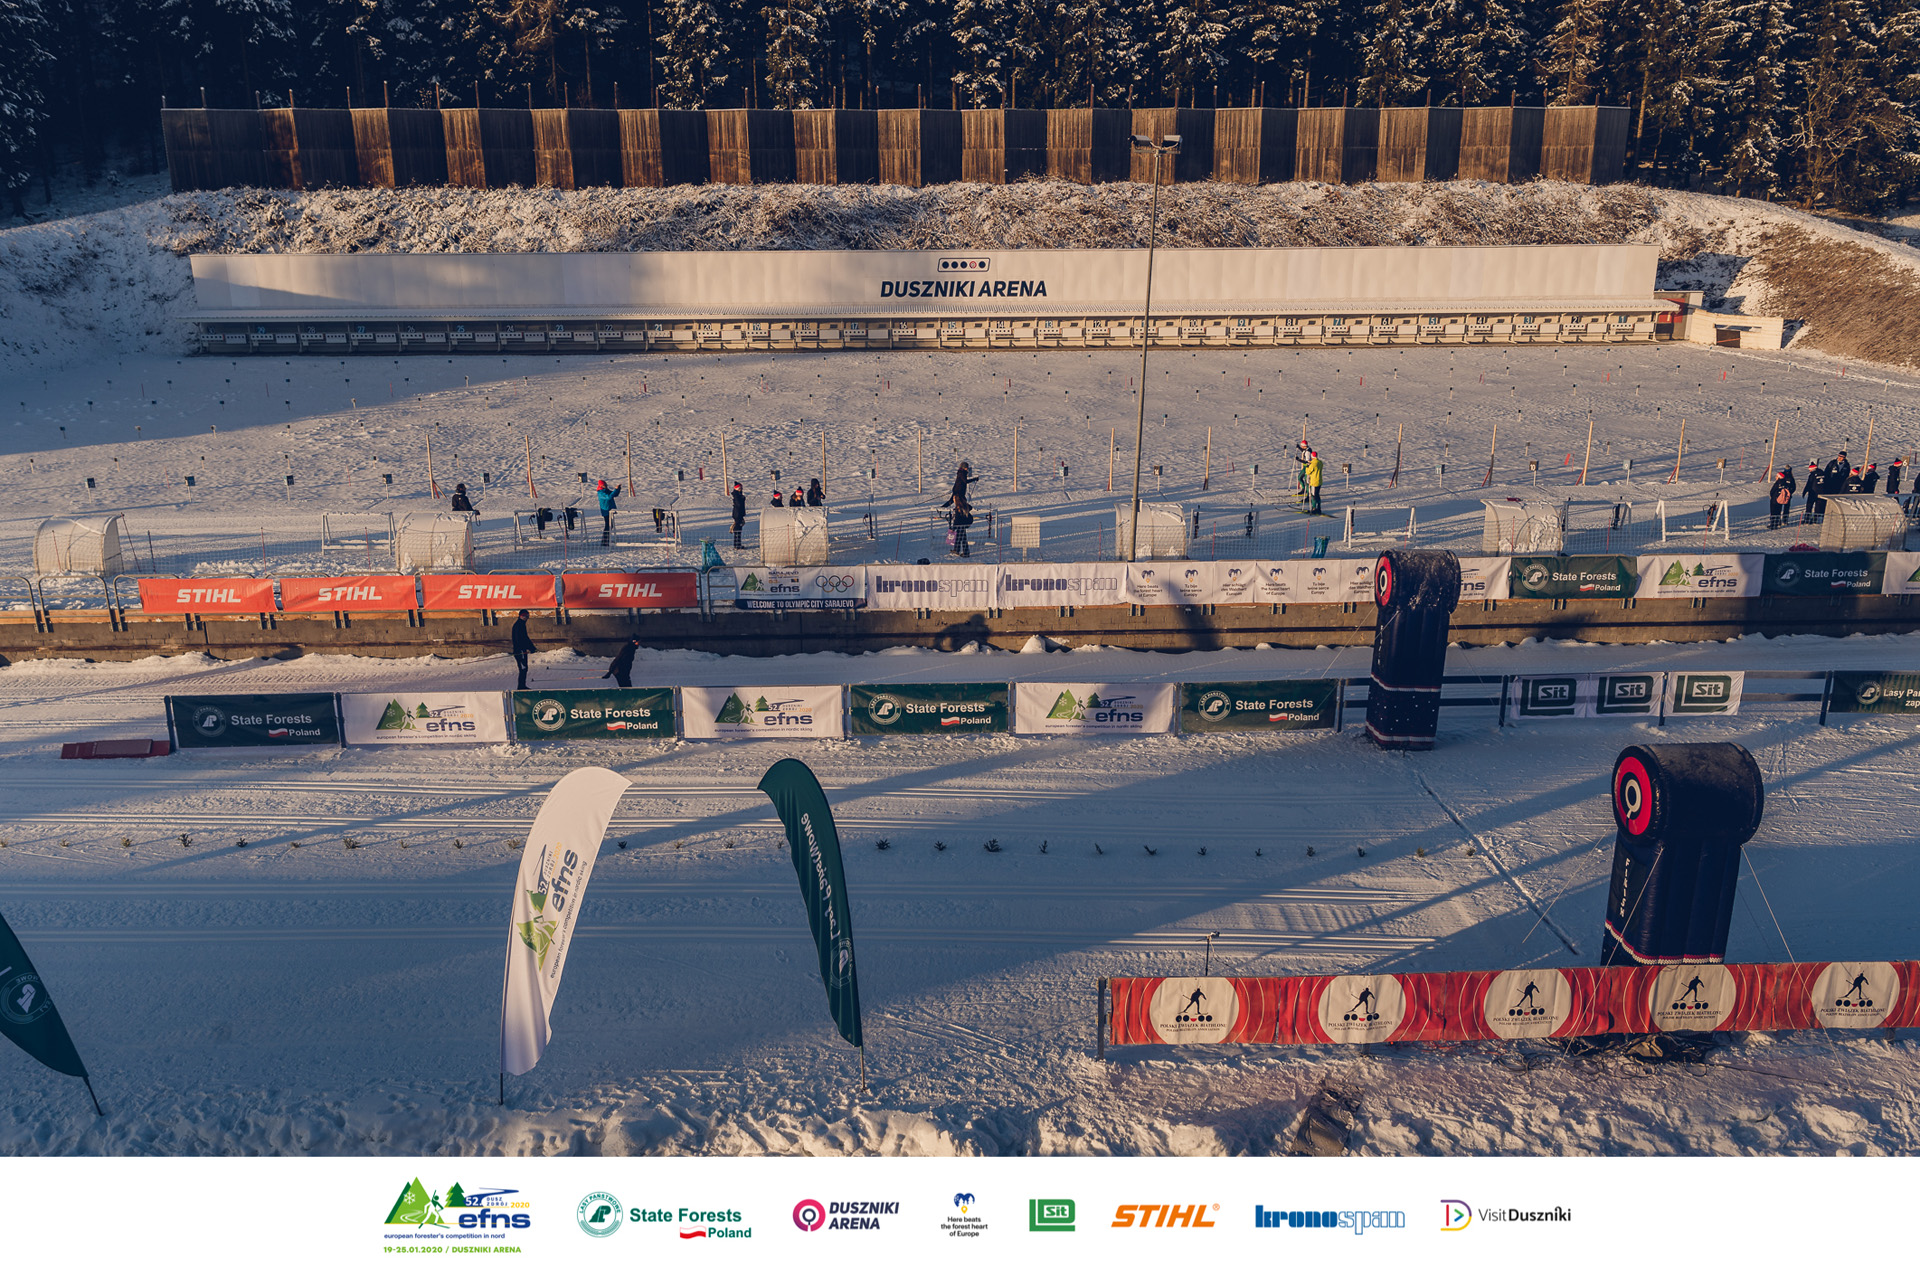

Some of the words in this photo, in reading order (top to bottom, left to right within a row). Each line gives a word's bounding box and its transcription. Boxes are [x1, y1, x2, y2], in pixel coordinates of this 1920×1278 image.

[880, 280, 976, 297] DUSZNIKI
[977, 280, 1048, 297] ARENA
[1552, 572, 1578, 581] State
[1580, 572, 1616, 581] Forests
[1804, 570, 1829, 578] State
[1832, 569, 1868, 578] Forests
[770, 584, 800, 592] efns
[875, 575, 989, 598] kronospan
[1005, 574, 1118, 596] kronospan
[1460, 580, 1486, 590] fns
[1698, 576, 1737, 588] efns
[176, 588, 242, 603] STIHL
[317, 586, 383, 601] STIHL
[457, 584, 523, 599] STIHL
[598, 583, 663, 598] STIHL
[747, 600, 775, 608] WELCOME
[776, 600, 784, 608] TO
[786, 600, 810, 608] OLYMPIC
[810, 600, 824, 608] CITY
[824, 600, 854, 608] SARAJEVO
[1540, 686, 1567, 699] Sit
[1617, 683, 1643, 697] Sit
[1695, 683, 1721, 696] Sit
[1884, 689, 1904, 698] Lasy
[906, 704, 937, 713] State
[940, 702, 985, 713] Forests
[1235, 700, 1266, 710] State
[1269, 699, 1313, 709] Forests
[231, 715, 262, 726] State
[266, 714, 312, 724] Forests
[570, 709, 601, 719] State
[605, 708, 650, 718] Forests
[764, 712, 813, 725] efns
[960, 716, 992, 724] Poland
[1095, 709, 1143, 722] efns
[426, 718, 476, 732] efns
[626, 722, 658, 730] Poland
[553, 842, 562, 860] 2020
[551, 849, 579, 912] efns
[1620, 858, 1630, 918] FINISH
[550, 952, 561, 979] european
[563, 898, 576, 929] competition
